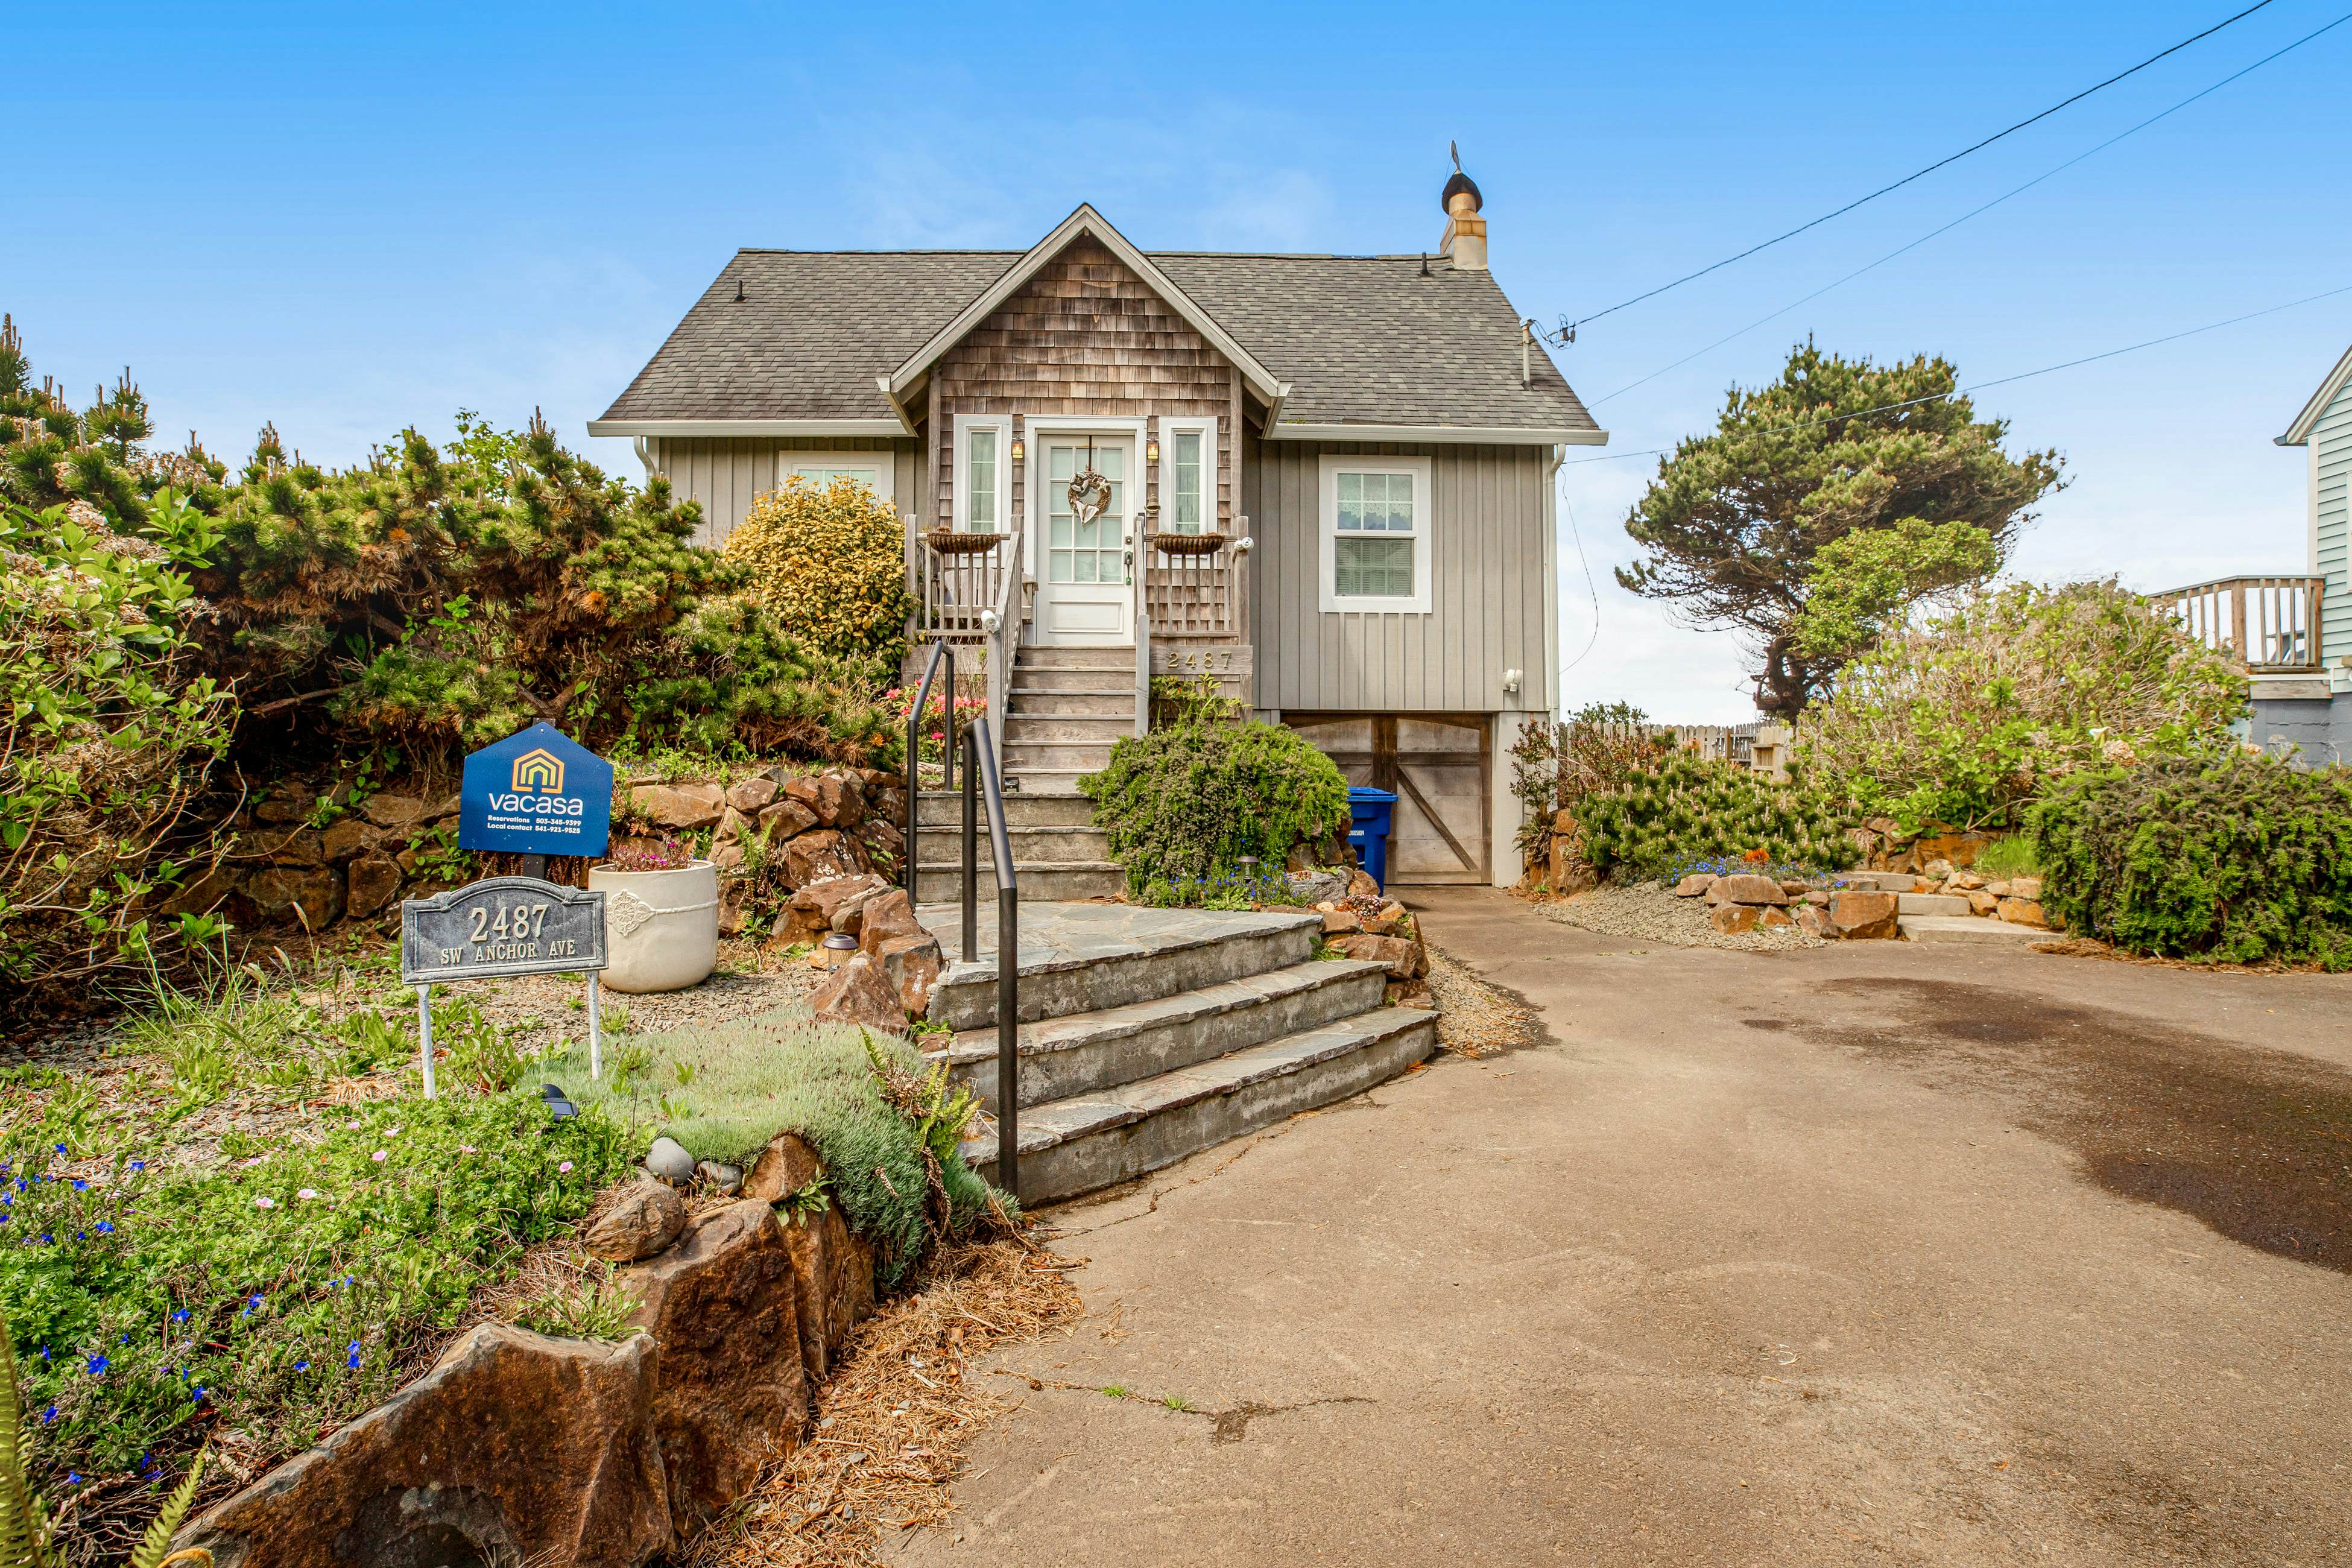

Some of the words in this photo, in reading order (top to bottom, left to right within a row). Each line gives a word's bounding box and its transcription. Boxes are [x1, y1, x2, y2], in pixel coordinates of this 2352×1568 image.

[1168, 652, 1231, 669] 2487
[488, 792, 583, 816] vacasa
[487, 815, 530, 824] Reservations
[536, 818, 581, 826] 503-345-9399
[535, 826, 581, 834] 541-921-9525
[470, 904, 549, 943] 2487
[441, 947, 463, 965] SW
[475, 942, 537, 963] ANCHOR
[549, 940, 576, 957] AVE
